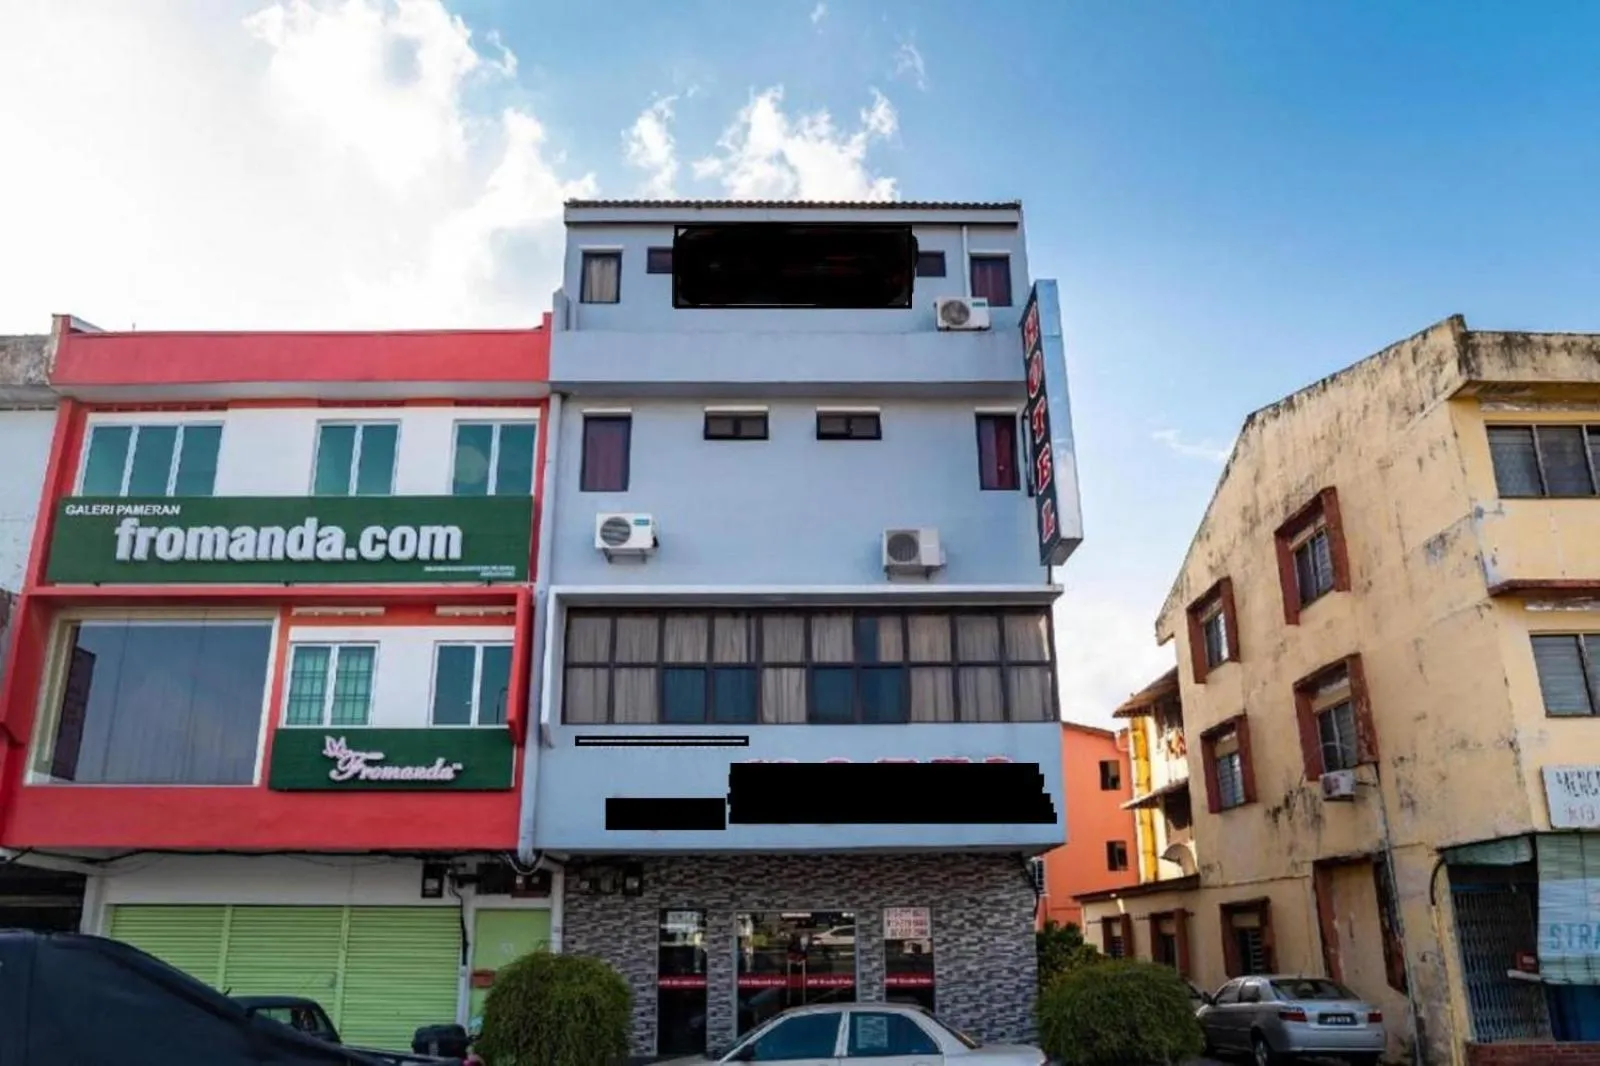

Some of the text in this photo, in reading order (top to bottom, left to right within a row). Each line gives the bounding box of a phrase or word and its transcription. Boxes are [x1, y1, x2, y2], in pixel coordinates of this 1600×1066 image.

[1024, 301, 1055, 544] HOTEL
[65, 504, 181, 516] GALERI PAMERAN
[114, 517, 462, 561] fromanda.com
[328, 751, 455, 781] Fromanda
